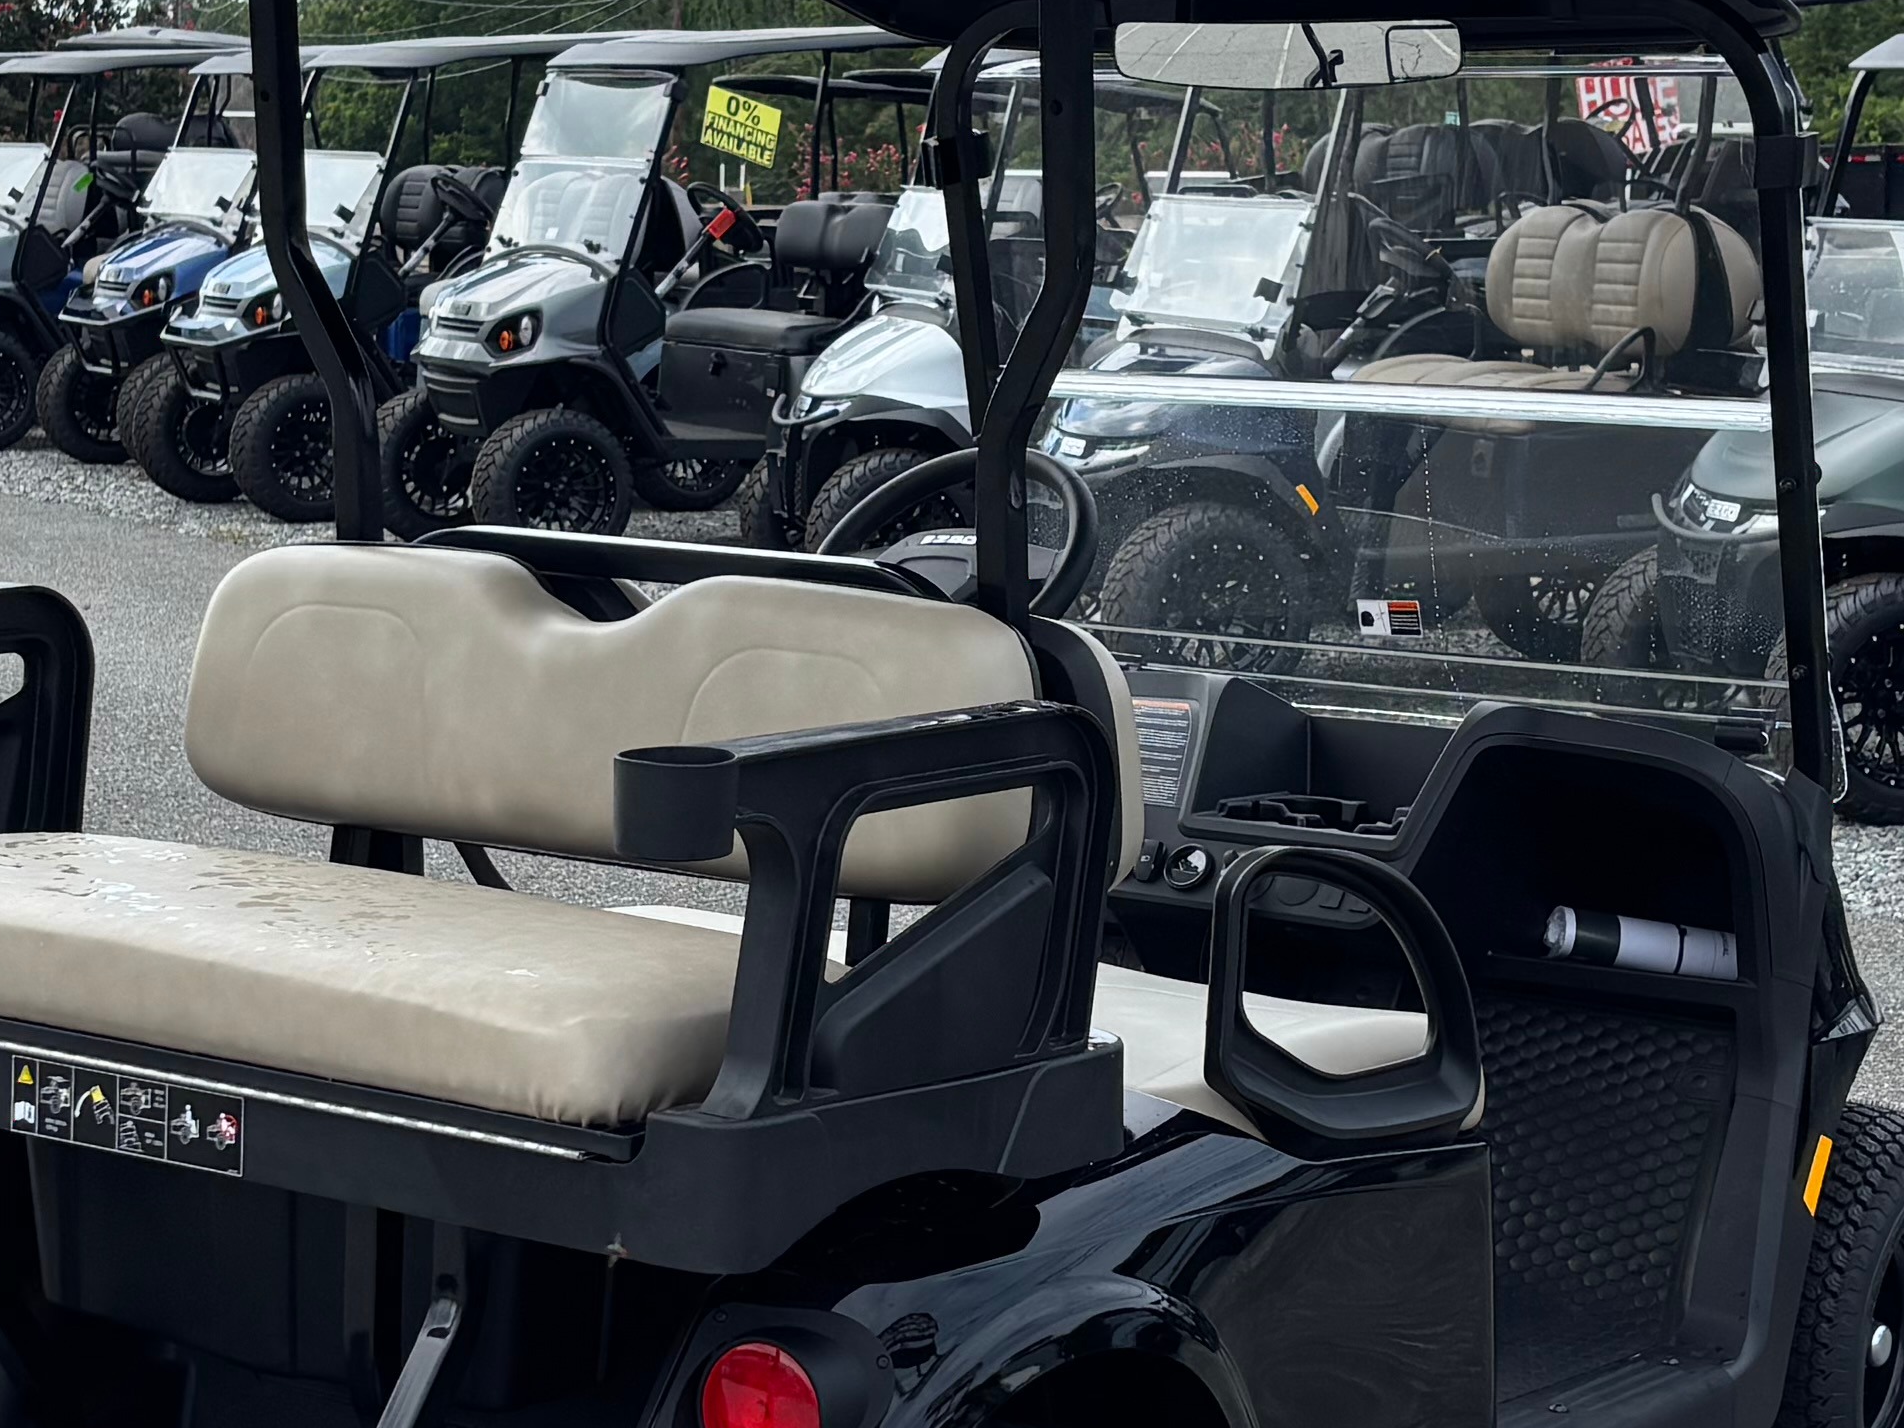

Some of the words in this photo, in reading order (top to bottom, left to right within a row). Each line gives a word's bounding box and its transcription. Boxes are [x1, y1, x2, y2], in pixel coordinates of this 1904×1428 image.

[726, 95, 760, 127] 0%
[704, 128, 773, 165] AVAILABLE
[706, 112, 776, 150] FINANCING
